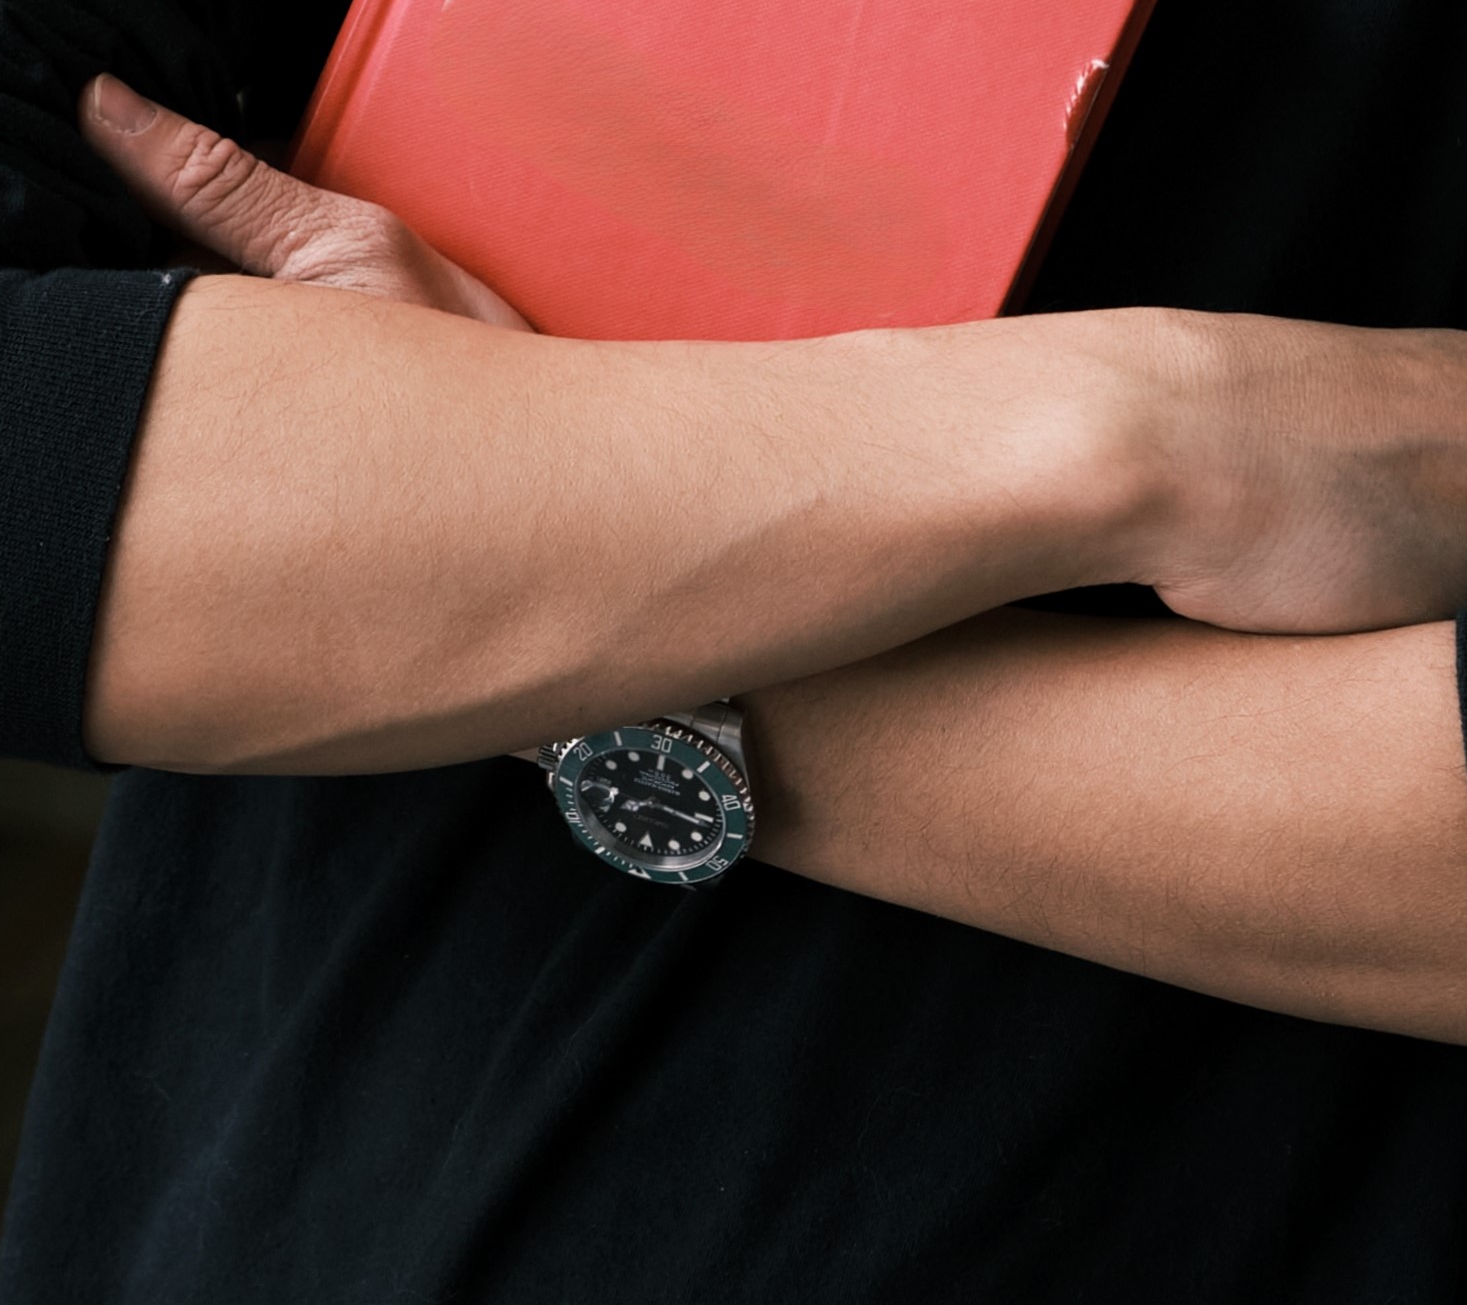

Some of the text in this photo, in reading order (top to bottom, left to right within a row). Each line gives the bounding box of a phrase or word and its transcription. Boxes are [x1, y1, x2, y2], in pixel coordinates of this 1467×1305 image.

[573, 742, 593, 761] 20
[651, 734, 672, 753] 30
[722, 794, 741, 811] 40
[706, 855, 728, 871] 50
